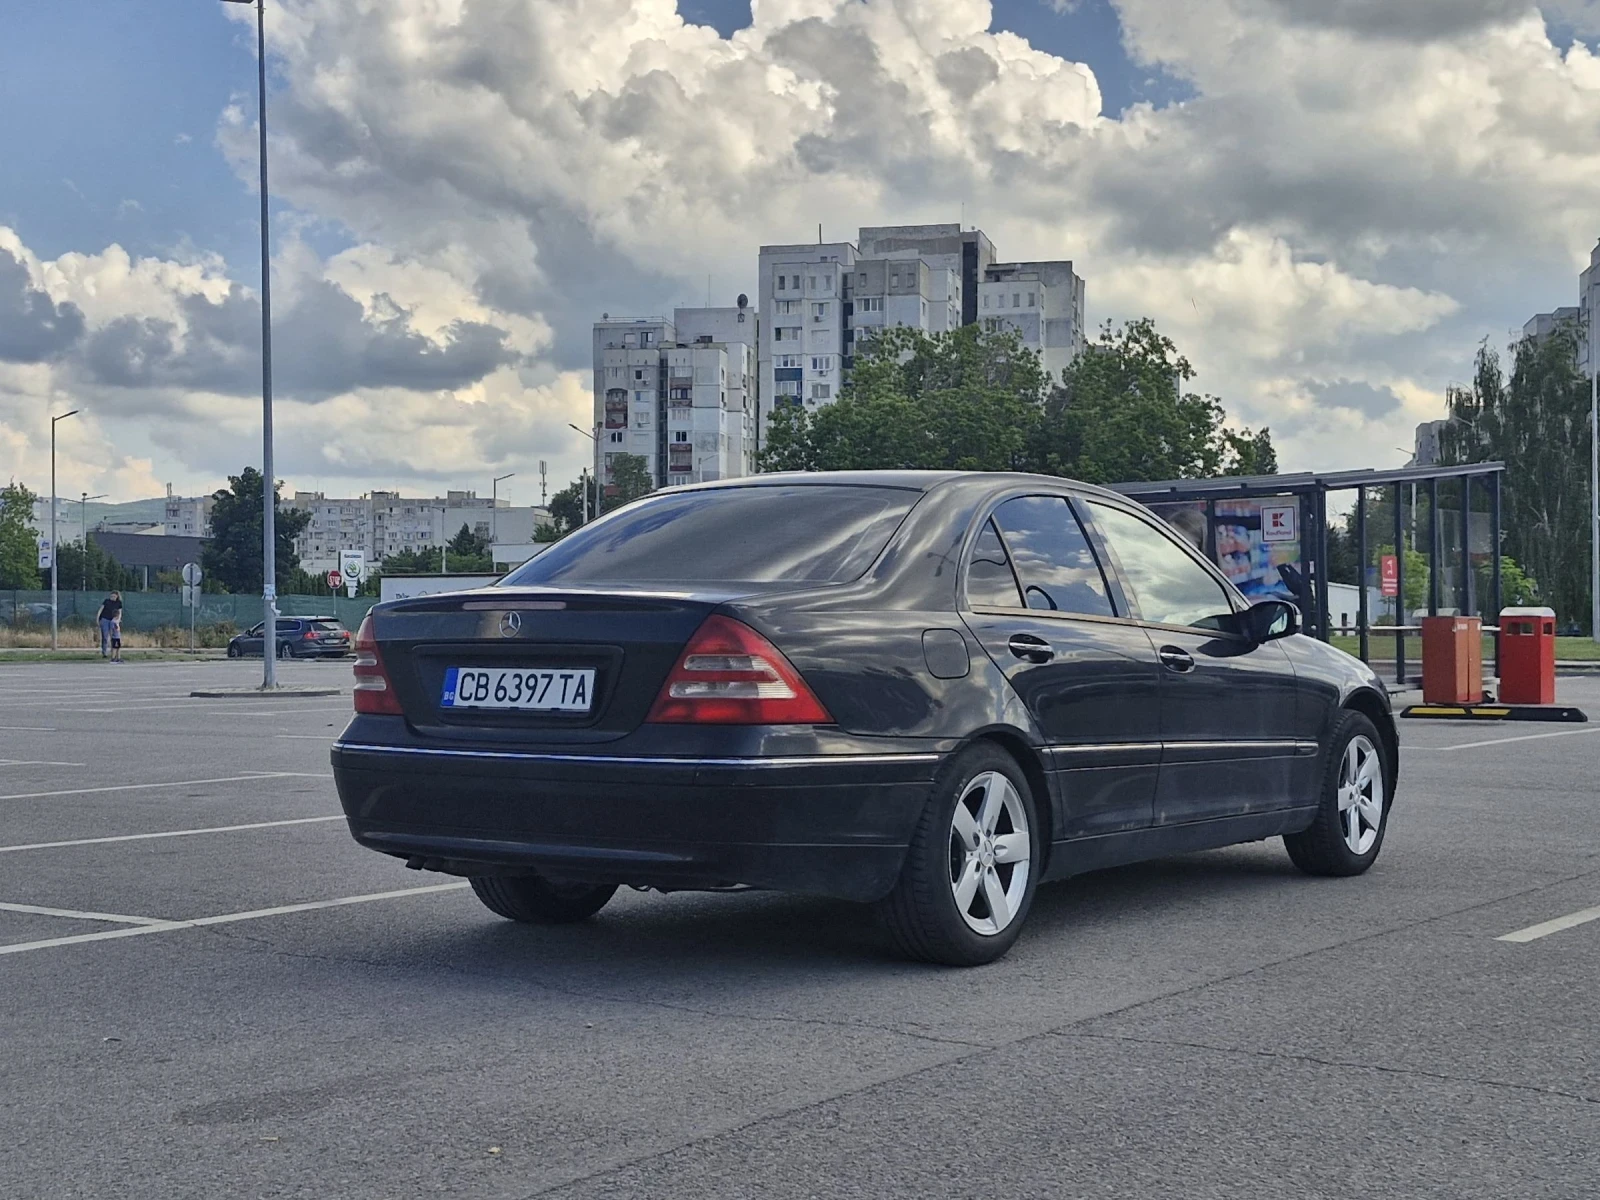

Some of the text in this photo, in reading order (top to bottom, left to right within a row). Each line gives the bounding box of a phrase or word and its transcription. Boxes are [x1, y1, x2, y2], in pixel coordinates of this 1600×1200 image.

[329, 575, 341, 585] STOP
[458, 672, 586, 704] CB 6397 TA
[444, 691, 454, 700] BG
